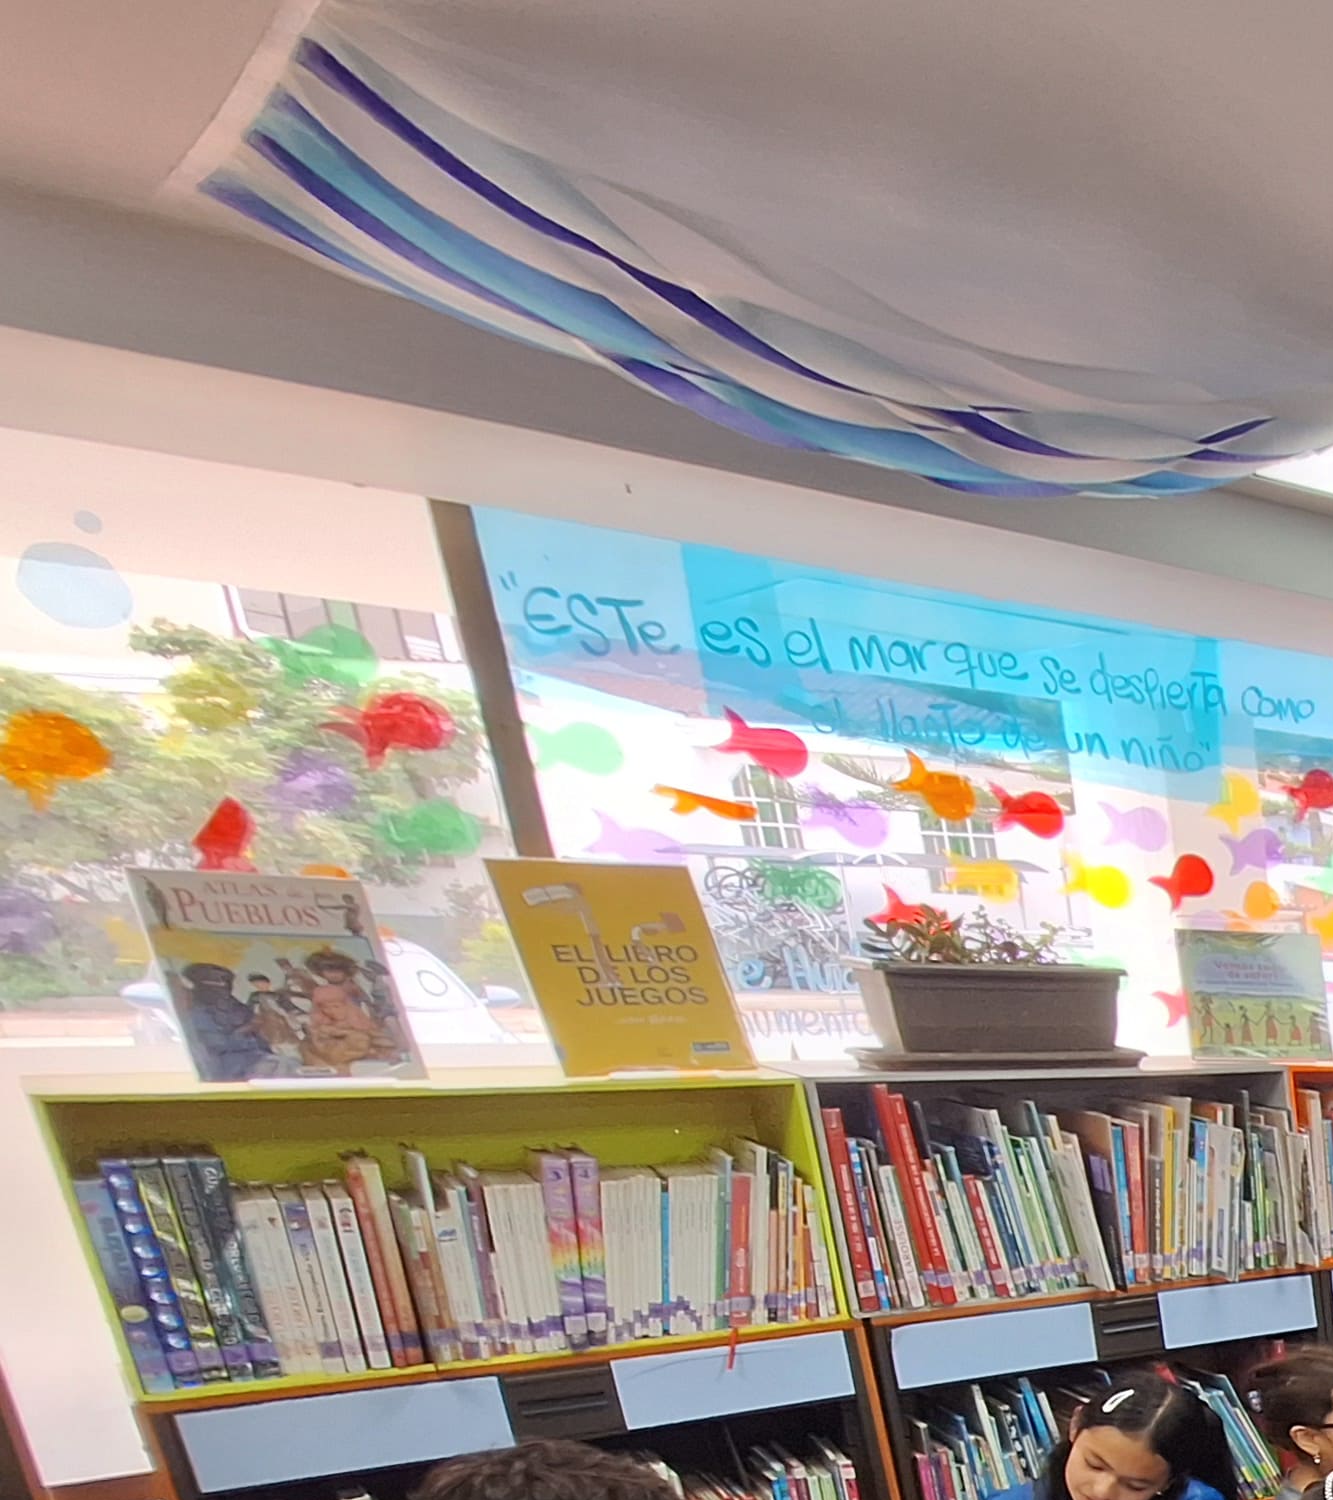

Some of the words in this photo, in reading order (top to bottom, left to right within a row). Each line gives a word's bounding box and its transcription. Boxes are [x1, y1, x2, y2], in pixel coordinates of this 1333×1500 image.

[700, 616, 773, 669] es
[784, 617, 833, 674] el
[943, 641, 1029, 689] que
[1067, 732, 1110, 761] un
[203, 880, 279, 898] ATLAS
[172, 886, 322, 928] PUEBLOS
[551, 944, 595, 963] EL
[604, 944, 699, 963] LIBRO
[629, 966, 692, 985] LOS
[576, 986, 710, 1007] JUEGOS
